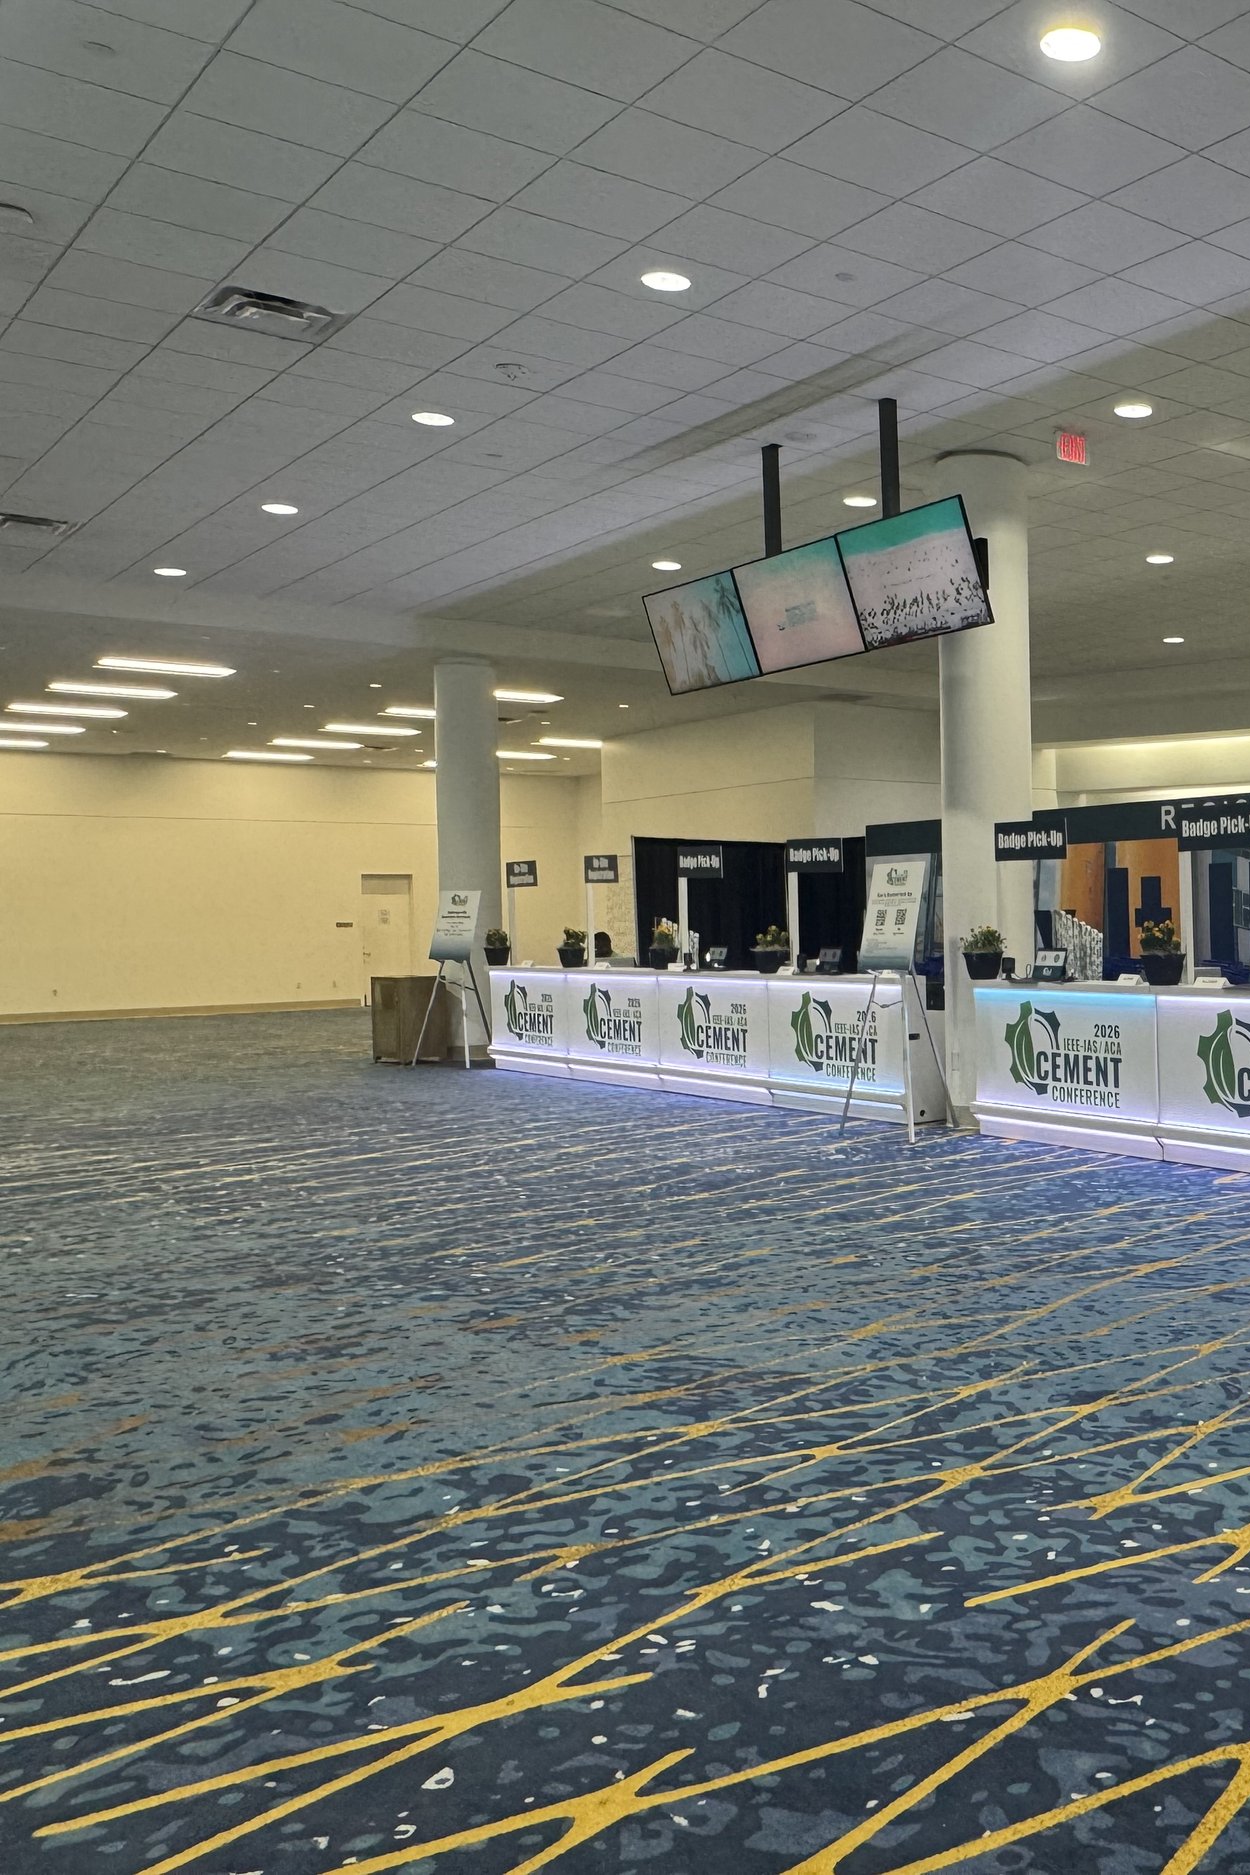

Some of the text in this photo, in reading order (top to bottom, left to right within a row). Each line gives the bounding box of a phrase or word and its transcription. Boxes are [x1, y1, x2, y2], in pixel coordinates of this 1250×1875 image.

[998, 830, 1063, 850] Badge Pick-Up
[1181, 818, 1217, 838] Badge
[517, 1011, 554, 1035] CEMENT
[856, 1010, 877, 1023] 206
[600, 1017, 642, 1043] CEMENT
[696, 1024, 748, 1053] CEMENT
[1094, 1023, 1120, 1039] 2026
[814, 1034, 878, 1065] CEMENT
[826, 1063, 876, 1083] CONFEENCE
[1036, 1050, 1123, 1089] CEMENT
[1052, 1085, 1120, 1109] CONFERENCE
